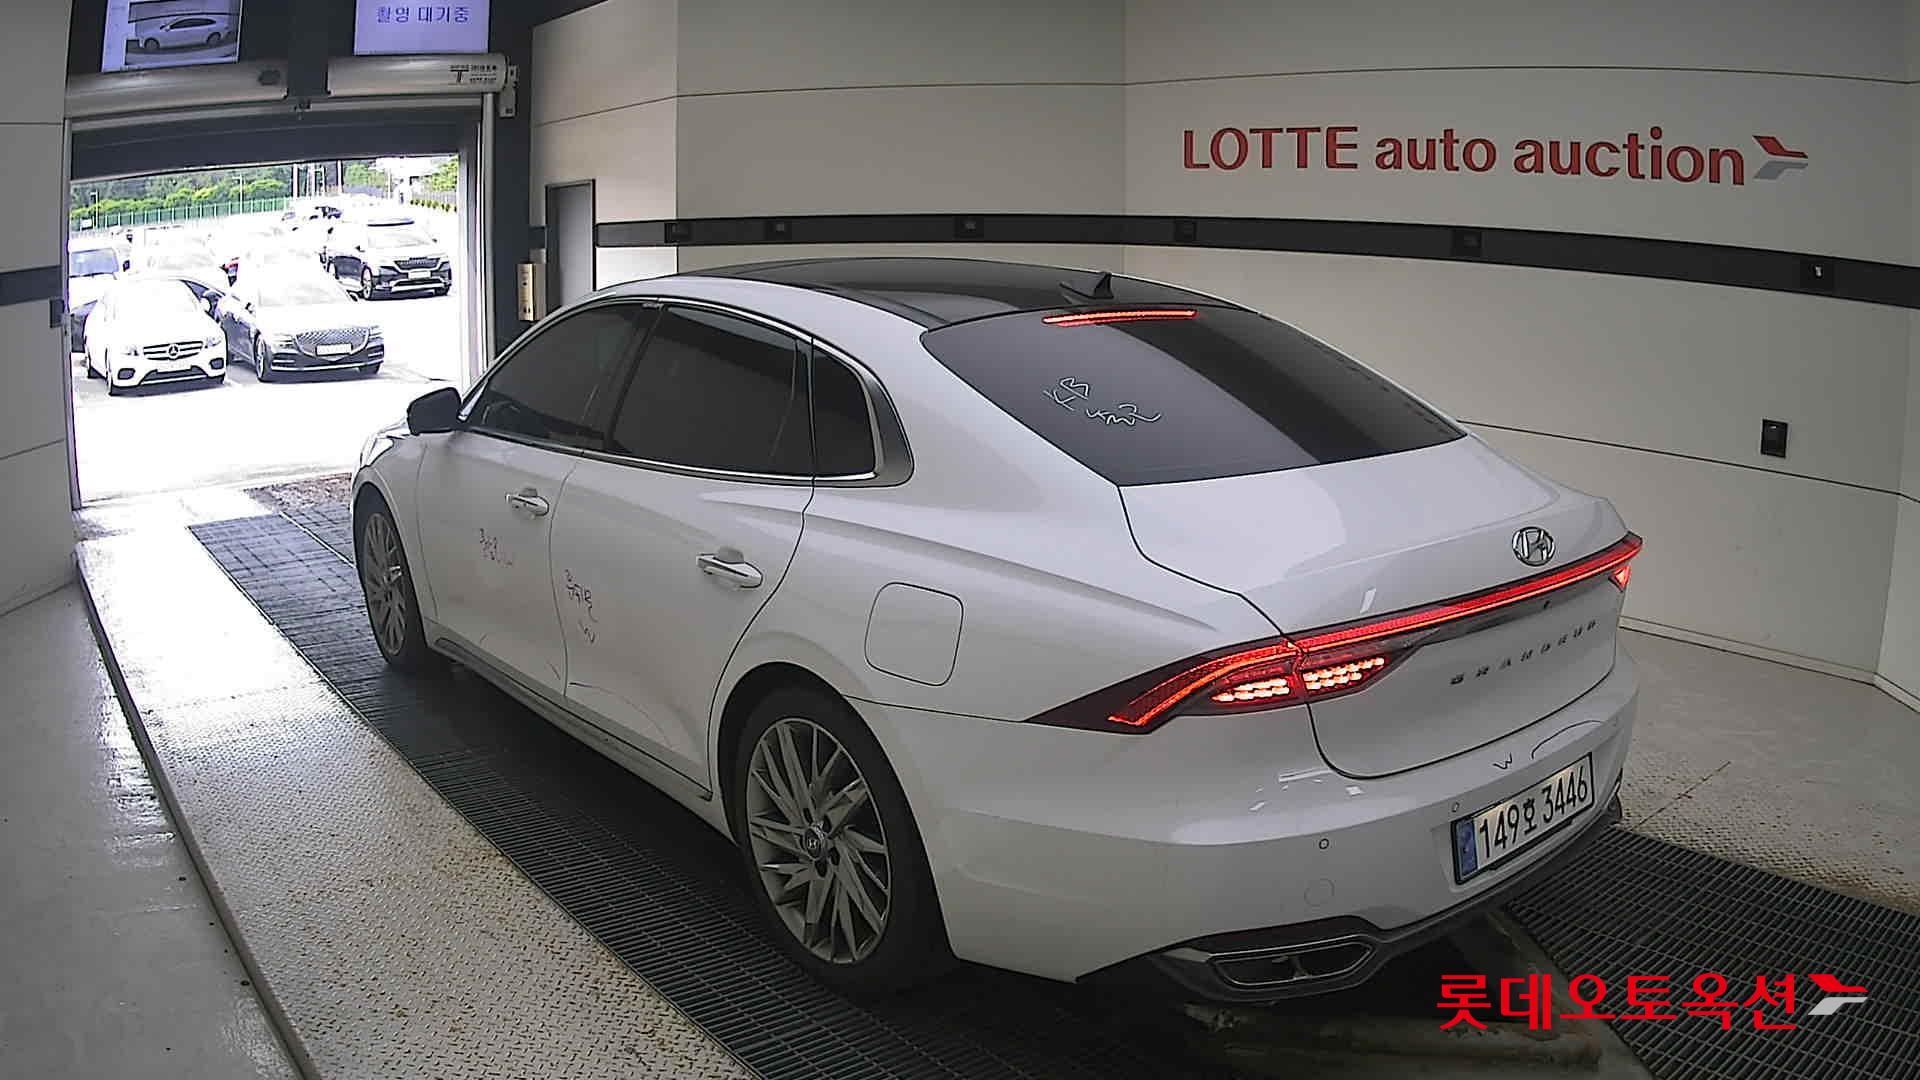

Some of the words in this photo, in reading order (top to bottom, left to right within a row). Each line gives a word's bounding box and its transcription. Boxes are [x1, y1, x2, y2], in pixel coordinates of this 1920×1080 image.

[417, 6, 470, 23] 대기중
[1184, 126, 1359, 170] LOTTE
[1375, 128, 1497, 173] auto
[1513, 126, 1745, 186] auction
[1450, 619, 1597, 686] GRANDEUR
[1541, 766, 1589, 824] 3446
